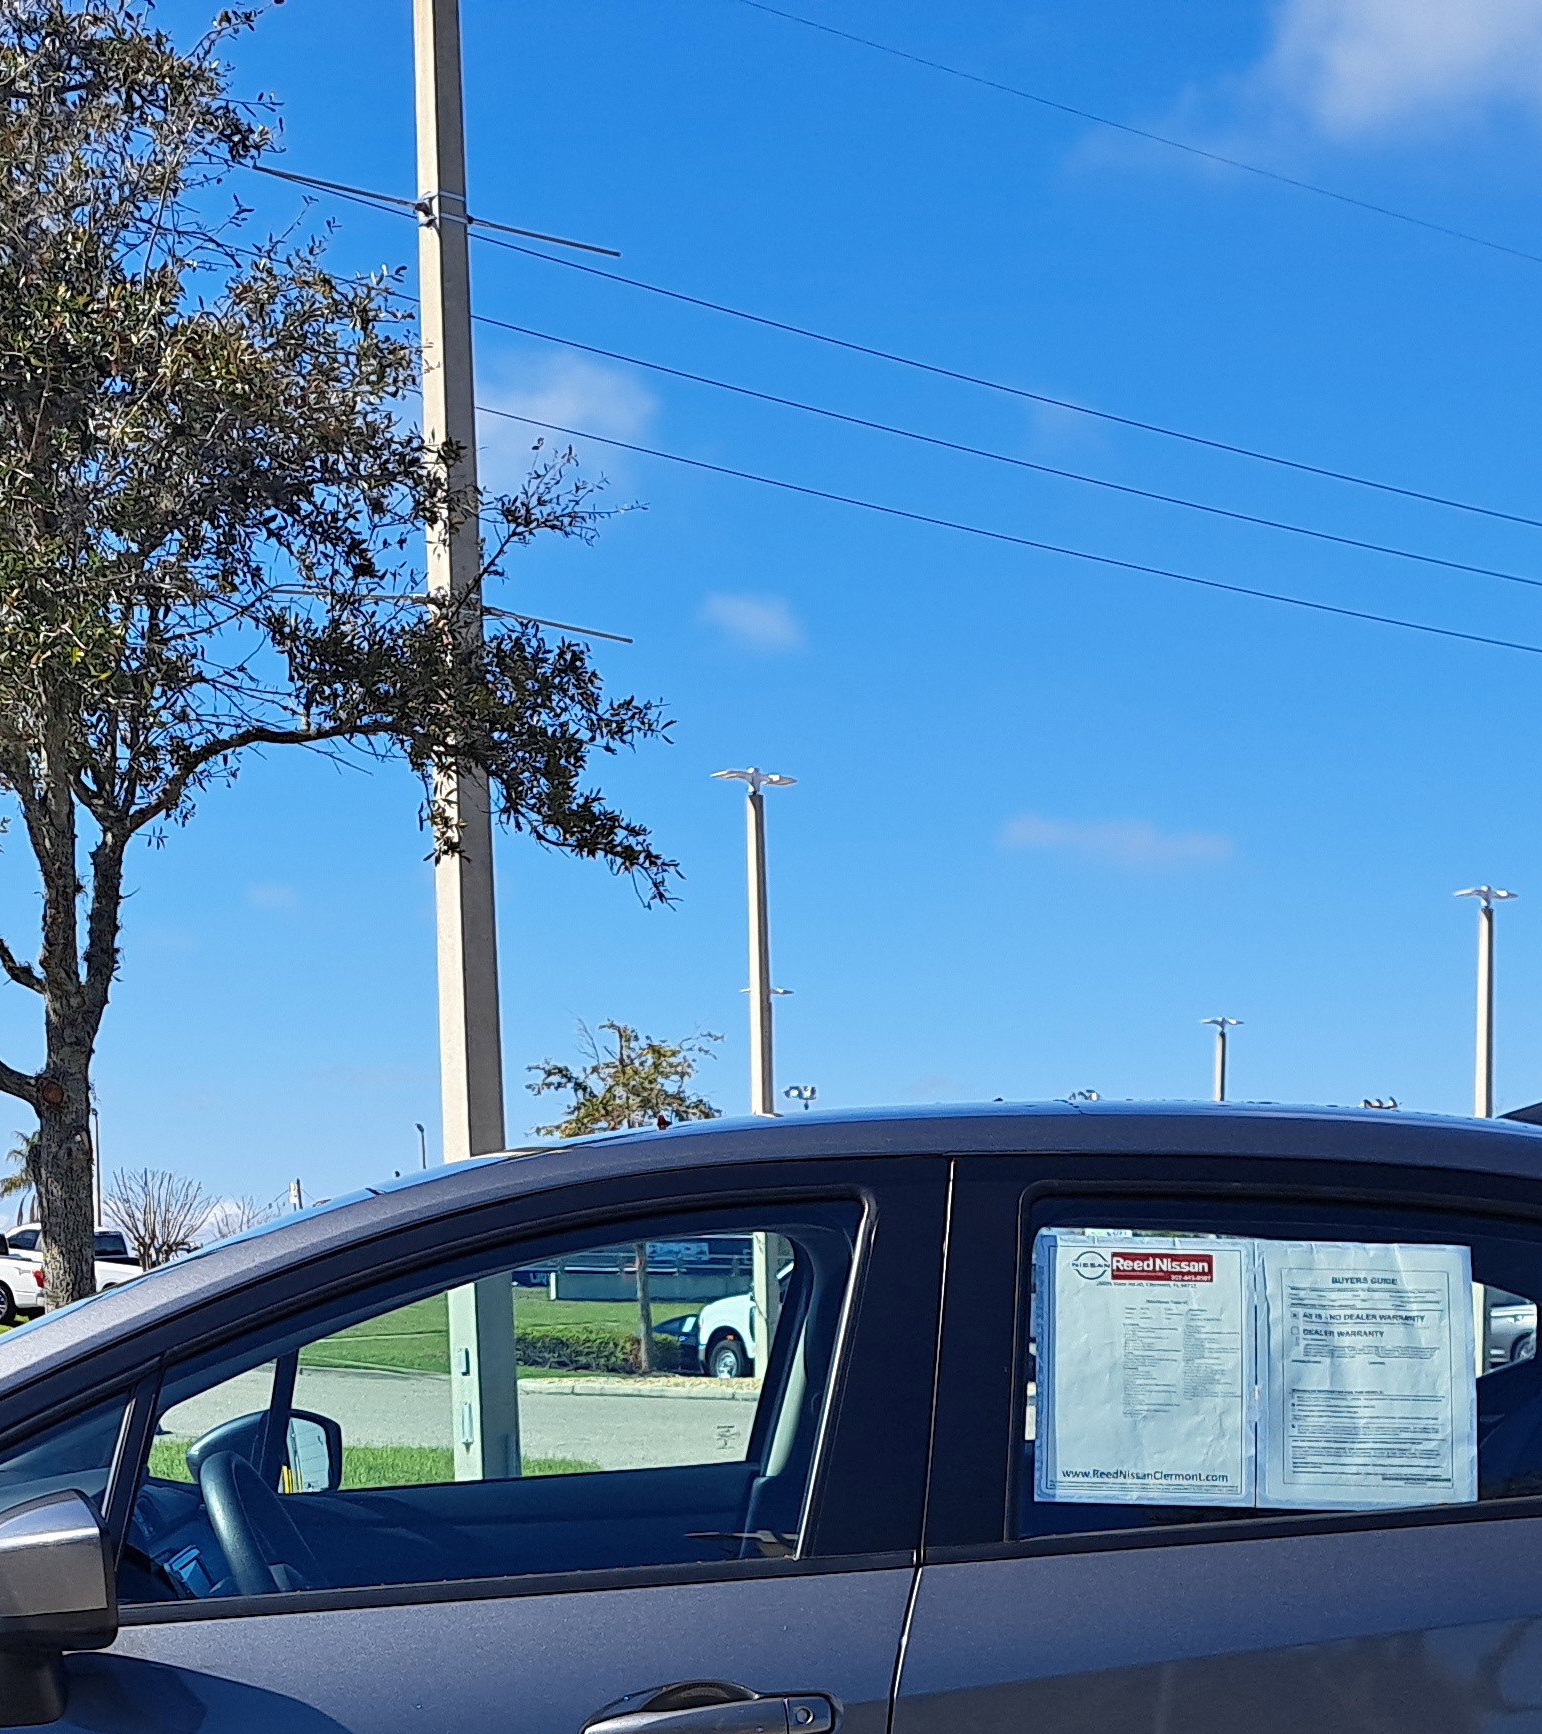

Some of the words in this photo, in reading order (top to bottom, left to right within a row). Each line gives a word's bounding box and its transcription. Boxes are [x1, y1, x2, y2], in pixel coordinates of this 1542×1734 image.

[1112, 1256, 1153, 1270] Reed
[1155, 1258, 1209, 1273] Nissan
[1331, 1276, 1368, 1284] BUYERS
[1370, 1277, 1398, 1285] GUIDE
[1379, 1314, 1426, 1322] WARRANTY
[1302, 1328, 1335, 1337] DEALER
[1336, 1330, 1385, 1338] WARRANTY
[1062, 1468, 1229, 1483] www.ReedNissanClermont.com
